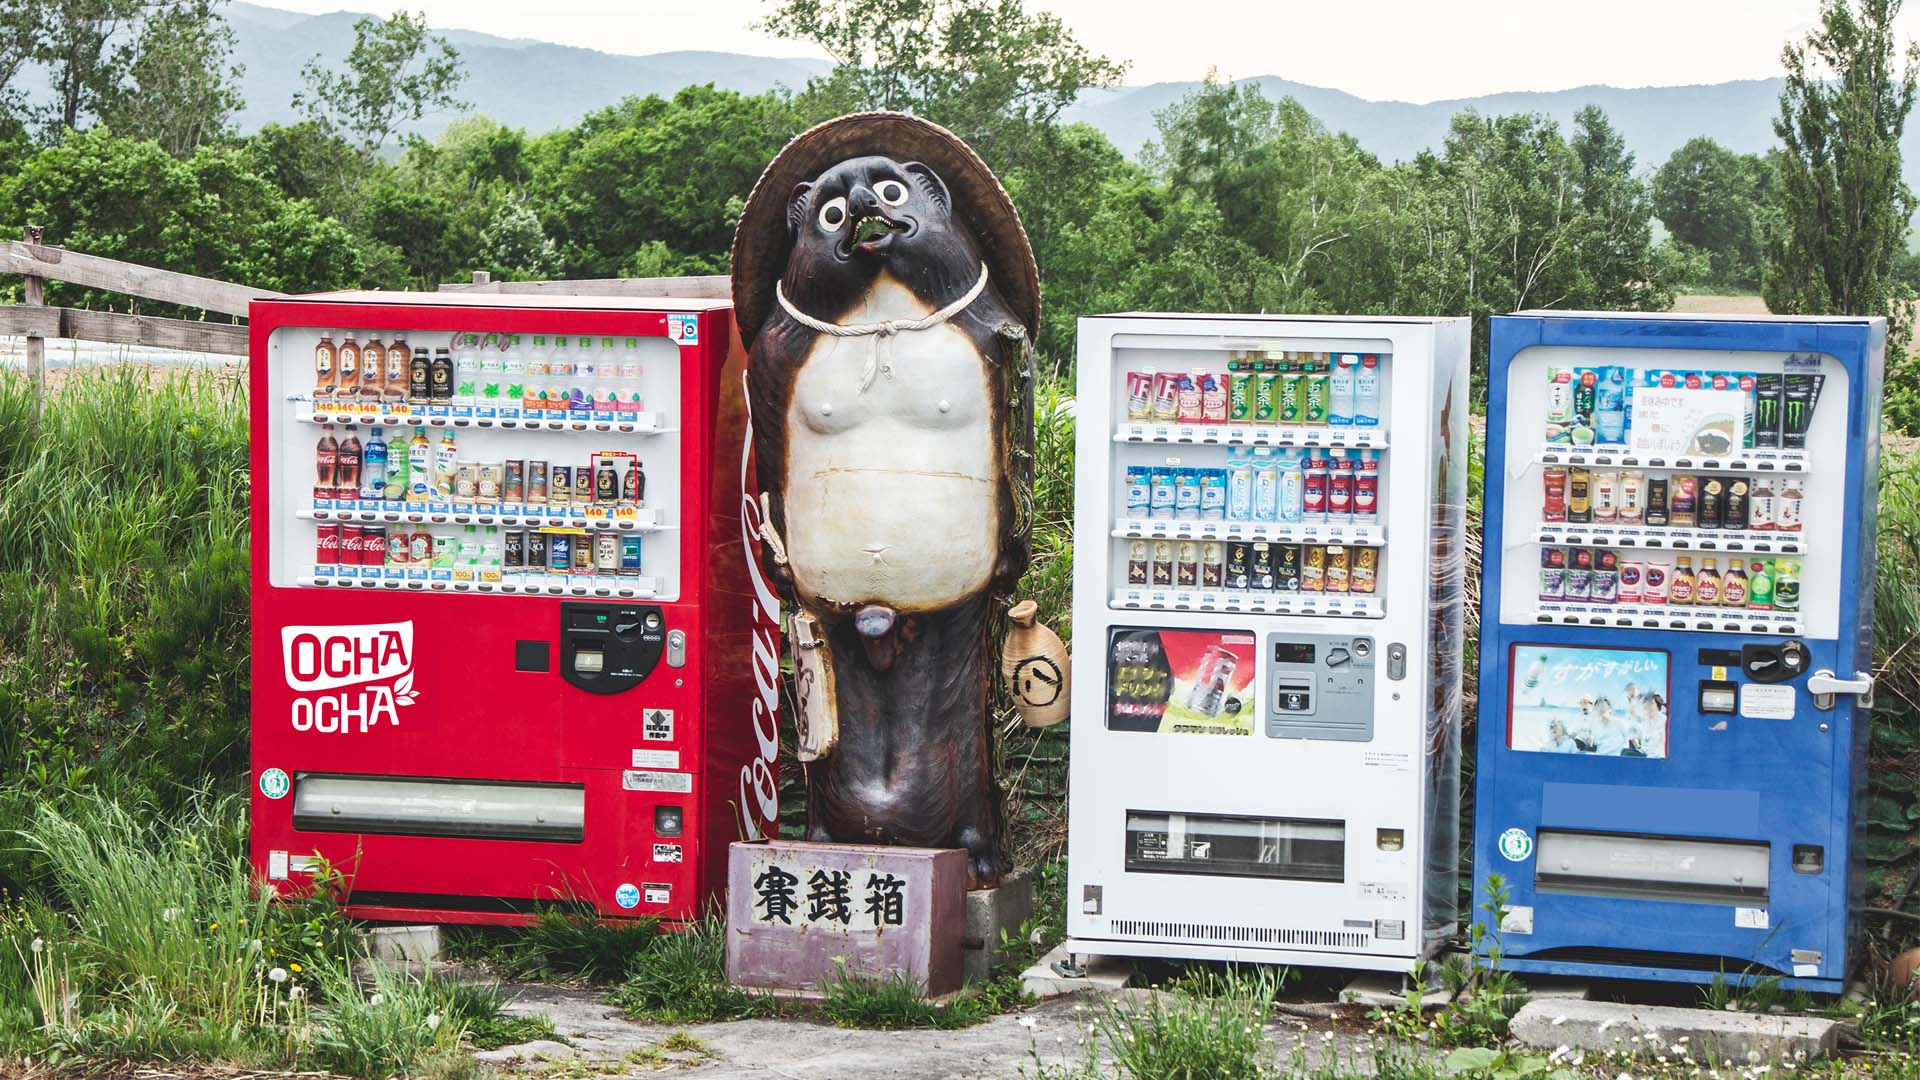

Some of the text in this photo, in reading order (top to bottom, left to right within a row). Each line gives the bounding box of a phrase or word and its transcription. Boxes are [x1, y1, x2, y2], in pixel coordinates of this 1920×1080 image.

[291, 631, 408, 682] OCHA
[291, 686, 400, 734] OCHA
[753, 865, 906, 926] 賽銭箱
